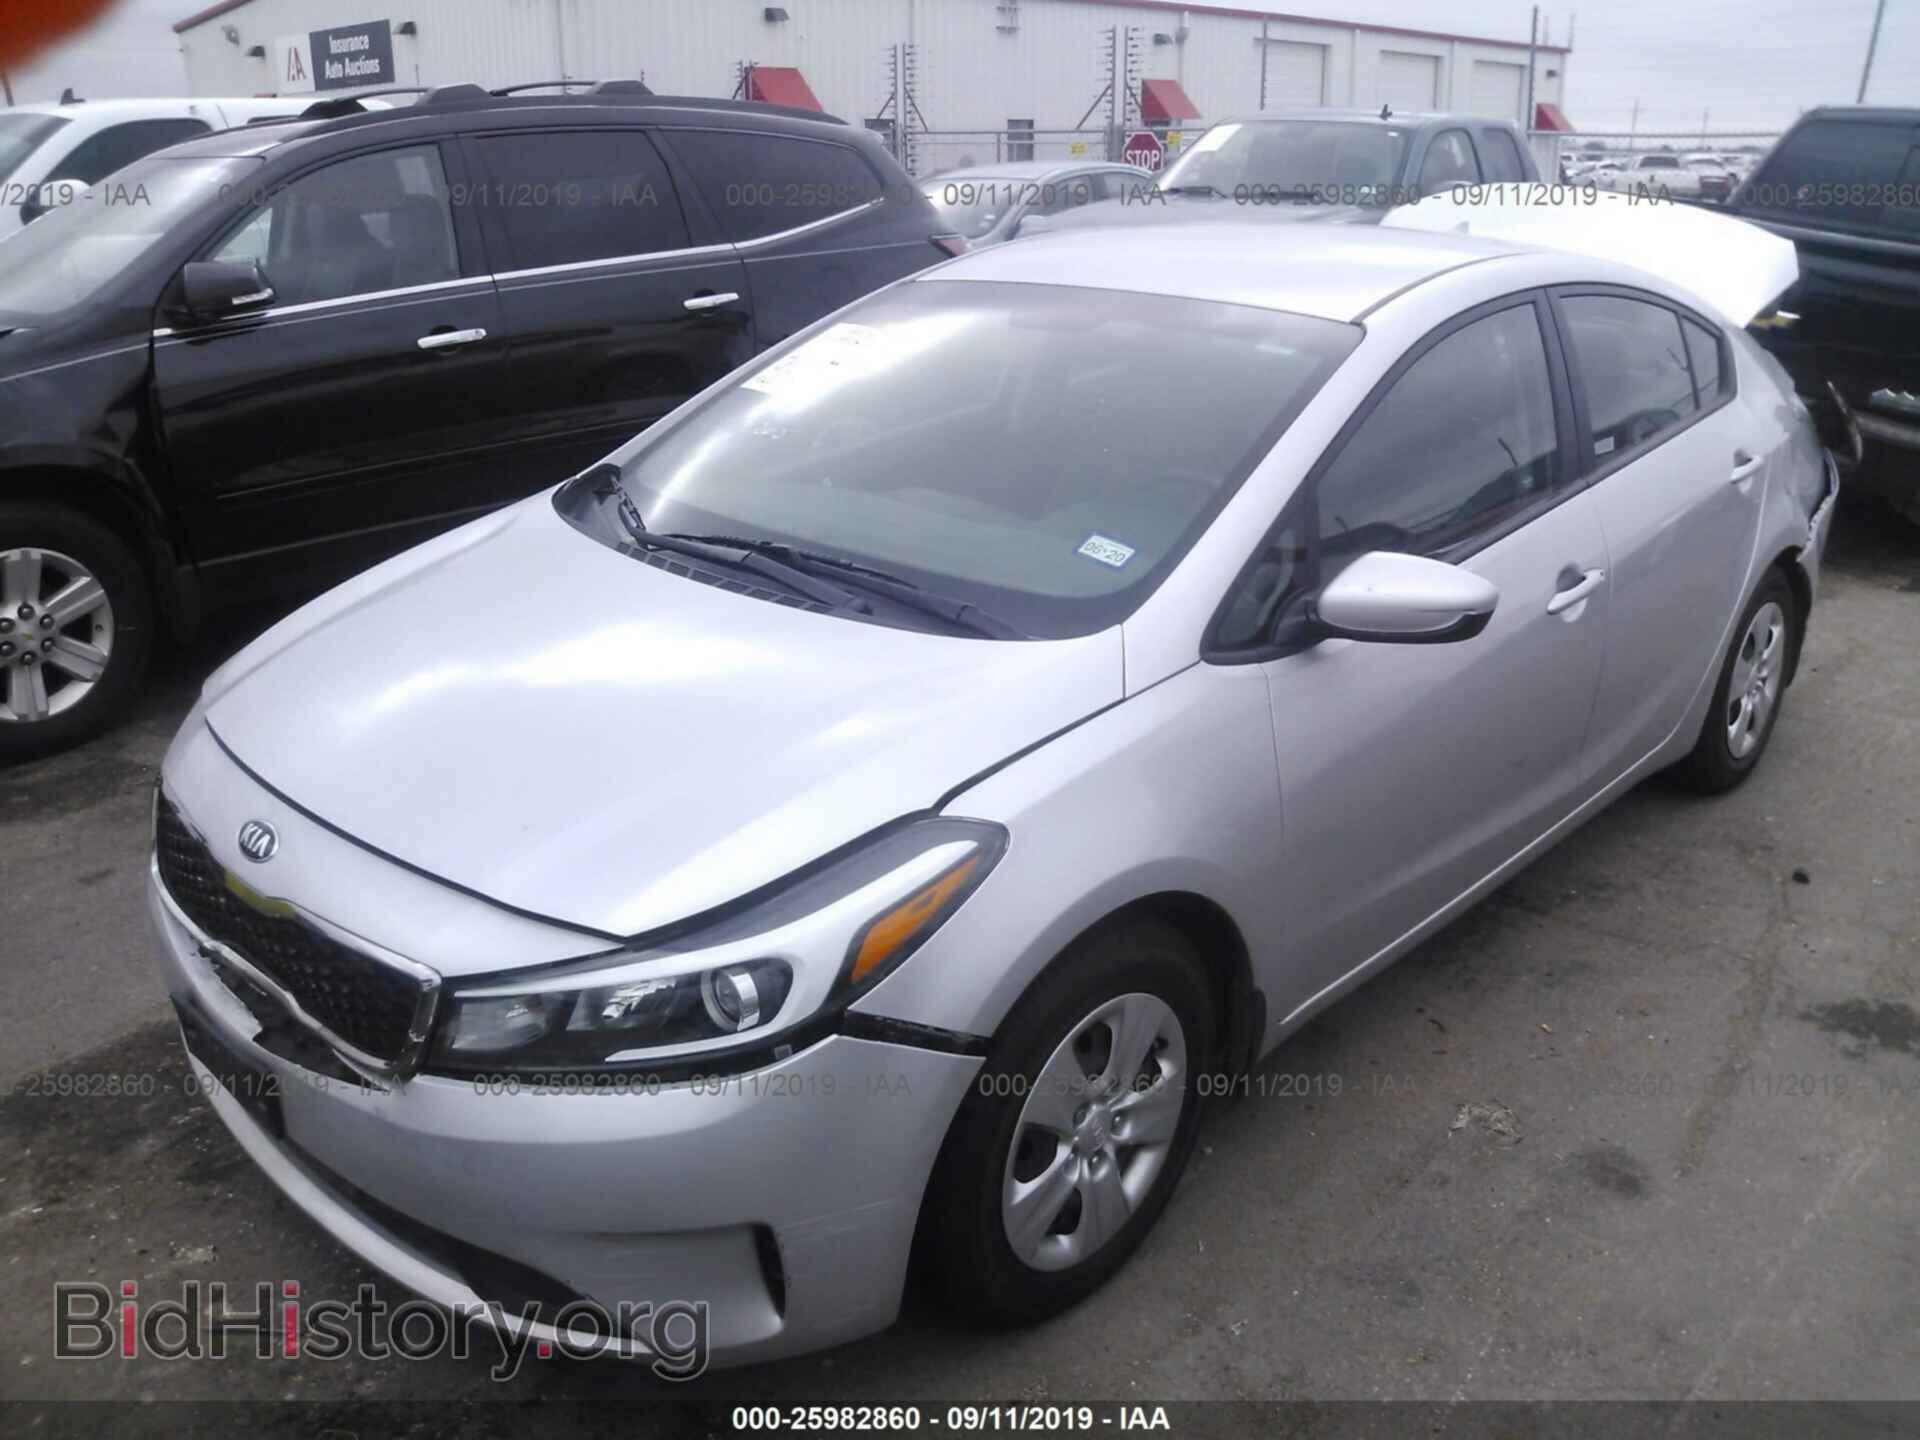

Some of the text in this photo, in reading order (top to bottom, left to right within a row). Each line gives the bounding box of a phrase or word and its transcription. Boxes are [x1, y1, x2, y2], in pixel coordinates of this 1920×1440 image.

[328, 34, 369, 54] Insurance
[325, 55, 380, 79] Auto Auctions
[1126, 150, 1160, 170] STOP
[240, 822, 272, 858] KIA
